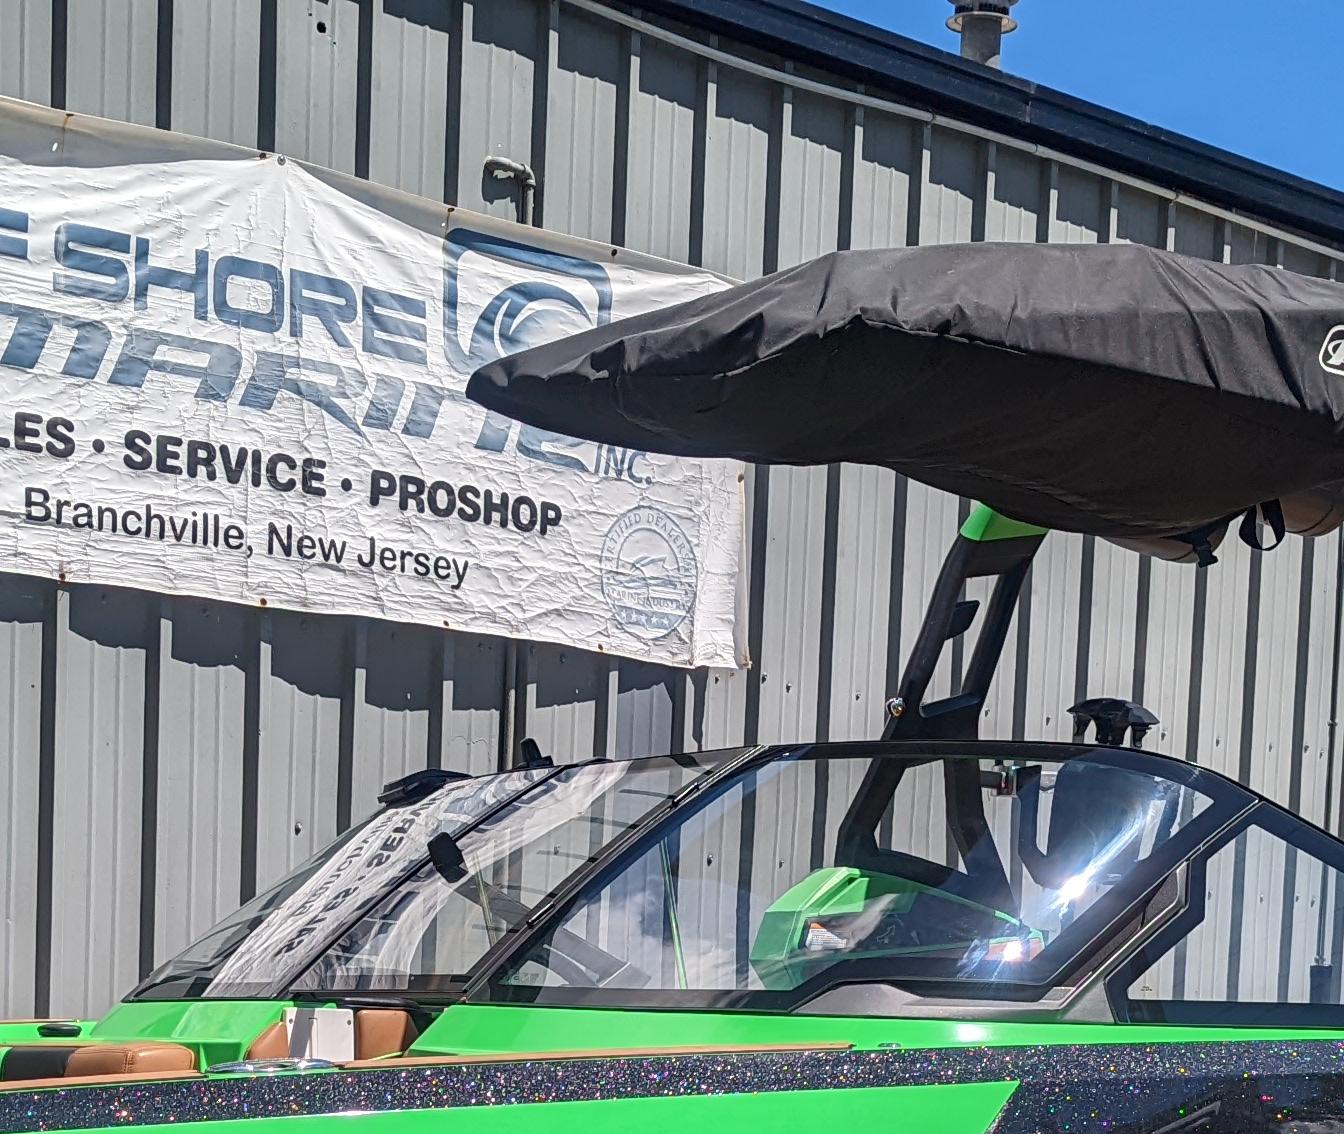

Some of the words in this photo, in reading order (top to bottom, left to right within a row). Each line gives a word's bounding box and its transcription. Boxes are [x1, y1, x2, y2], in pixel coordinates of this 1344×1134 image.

[52, 222, 428, 365] SHORE
[123, 429, 327, 497] SERVICE
[369, 469, 562, 536] PROSHOP
[592, 441, 652, 485] INC.
[25, 486, 253, 558] Branchville,
[267, 522, 347, 564] New
[356, 536, 470, 590] Jersey
[604, 513, 642, 568] ERTIFIED
